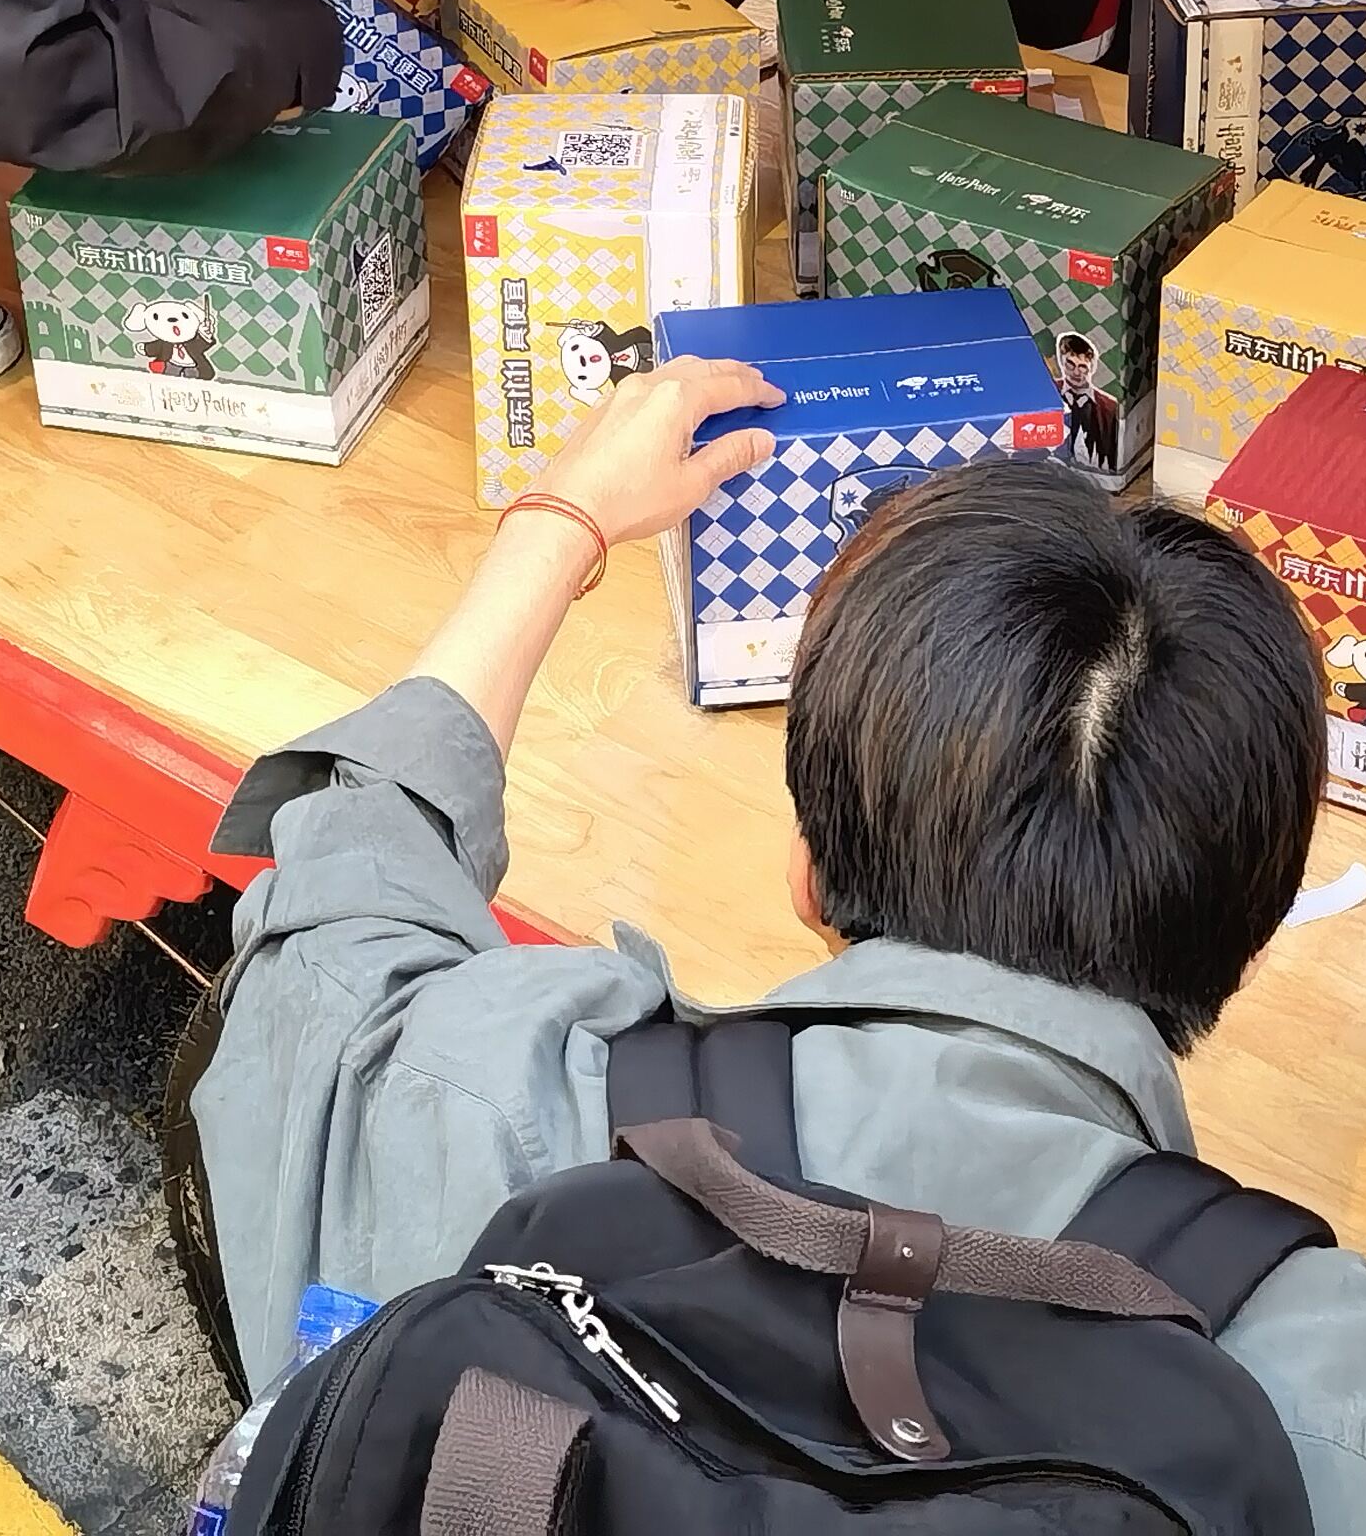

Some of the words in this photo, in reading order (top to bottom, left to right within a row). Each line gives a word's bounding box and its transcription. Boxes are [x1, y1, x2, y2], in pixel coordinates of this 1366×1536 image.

[378, 42, 433, 90] 真便宜
[176, 257, 250, 285] 真便宜
[502, 279, 530, 351] 真便宜
[794, 389, 832, 405] Harry
[831, 385, 871, 401] Potter
